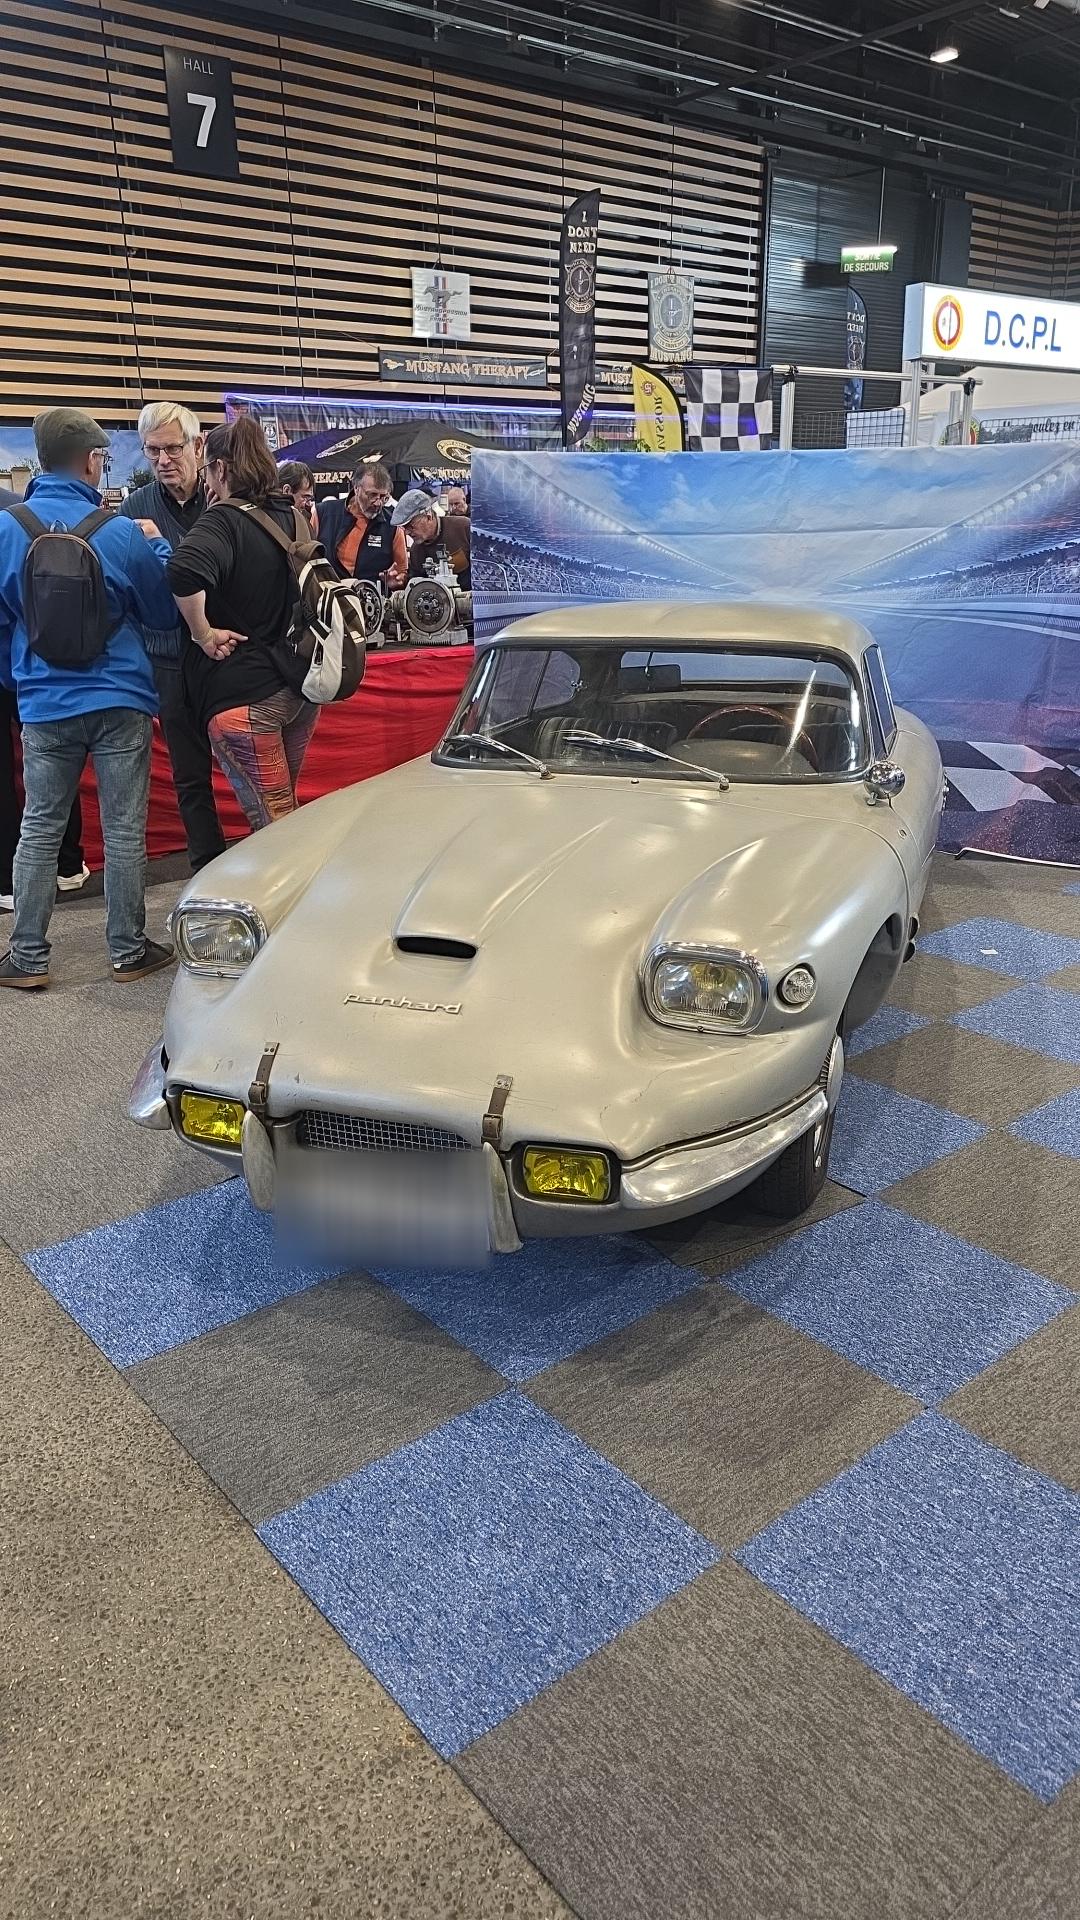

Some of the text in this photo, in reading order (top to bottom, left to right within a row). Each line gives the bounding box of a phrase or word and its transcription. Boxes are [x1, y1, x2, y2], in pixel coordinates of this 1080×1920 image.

[183, 57, 214, 75] HALL
[187, 93, 217, 148] 7
[581, 211, 587, 222] I
[569, 241, 596, 254] NEED
[844, 262, 889, 272] DE SECOURS
[650, 345, 693, 363] MUSTANG
[405, 359, 530, 380] MUSTANG THERAPY
[600, 372, 633, 385] MUST
[501, 423, 528, 435] TIRE
[1032, 418, 1060, 435] oulez
[438, 468, 471, 481] MUSTA
[343, 993, 462, 1015] panhard
